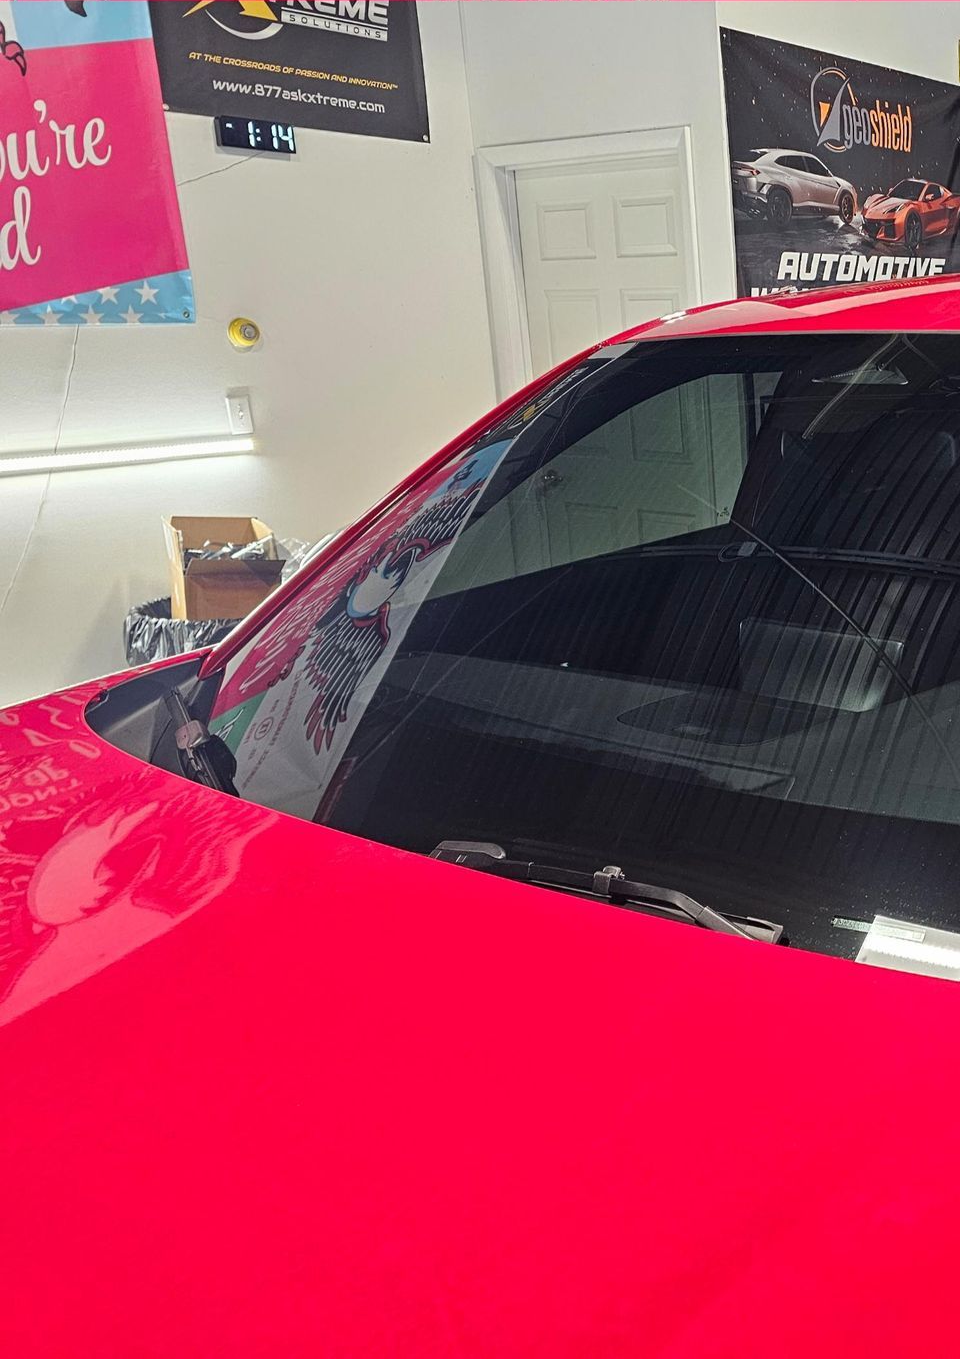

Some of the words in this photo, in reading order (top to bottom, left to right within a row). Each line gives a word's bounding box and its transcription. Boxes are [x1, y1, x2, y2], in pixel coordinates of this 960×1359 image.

[289, 14, 381, 39] SOLUTIONS
[188, 51, 202, 60] AT
[204, 53, 222, 64] THE
[223, 57, 281, 73] CROSSROADS
[282, 66, 295, 75] OF
[295, 68, 330, 81] PASSION
[331, 74, 348, 84] AND
[212, 79, 386, 114] www.877askxtreme.com
[0, 99, 112, 181] u're
[842, 99, 912, 153] geoshield
[777, 251, 946, 282] AUTOMOTIVE
